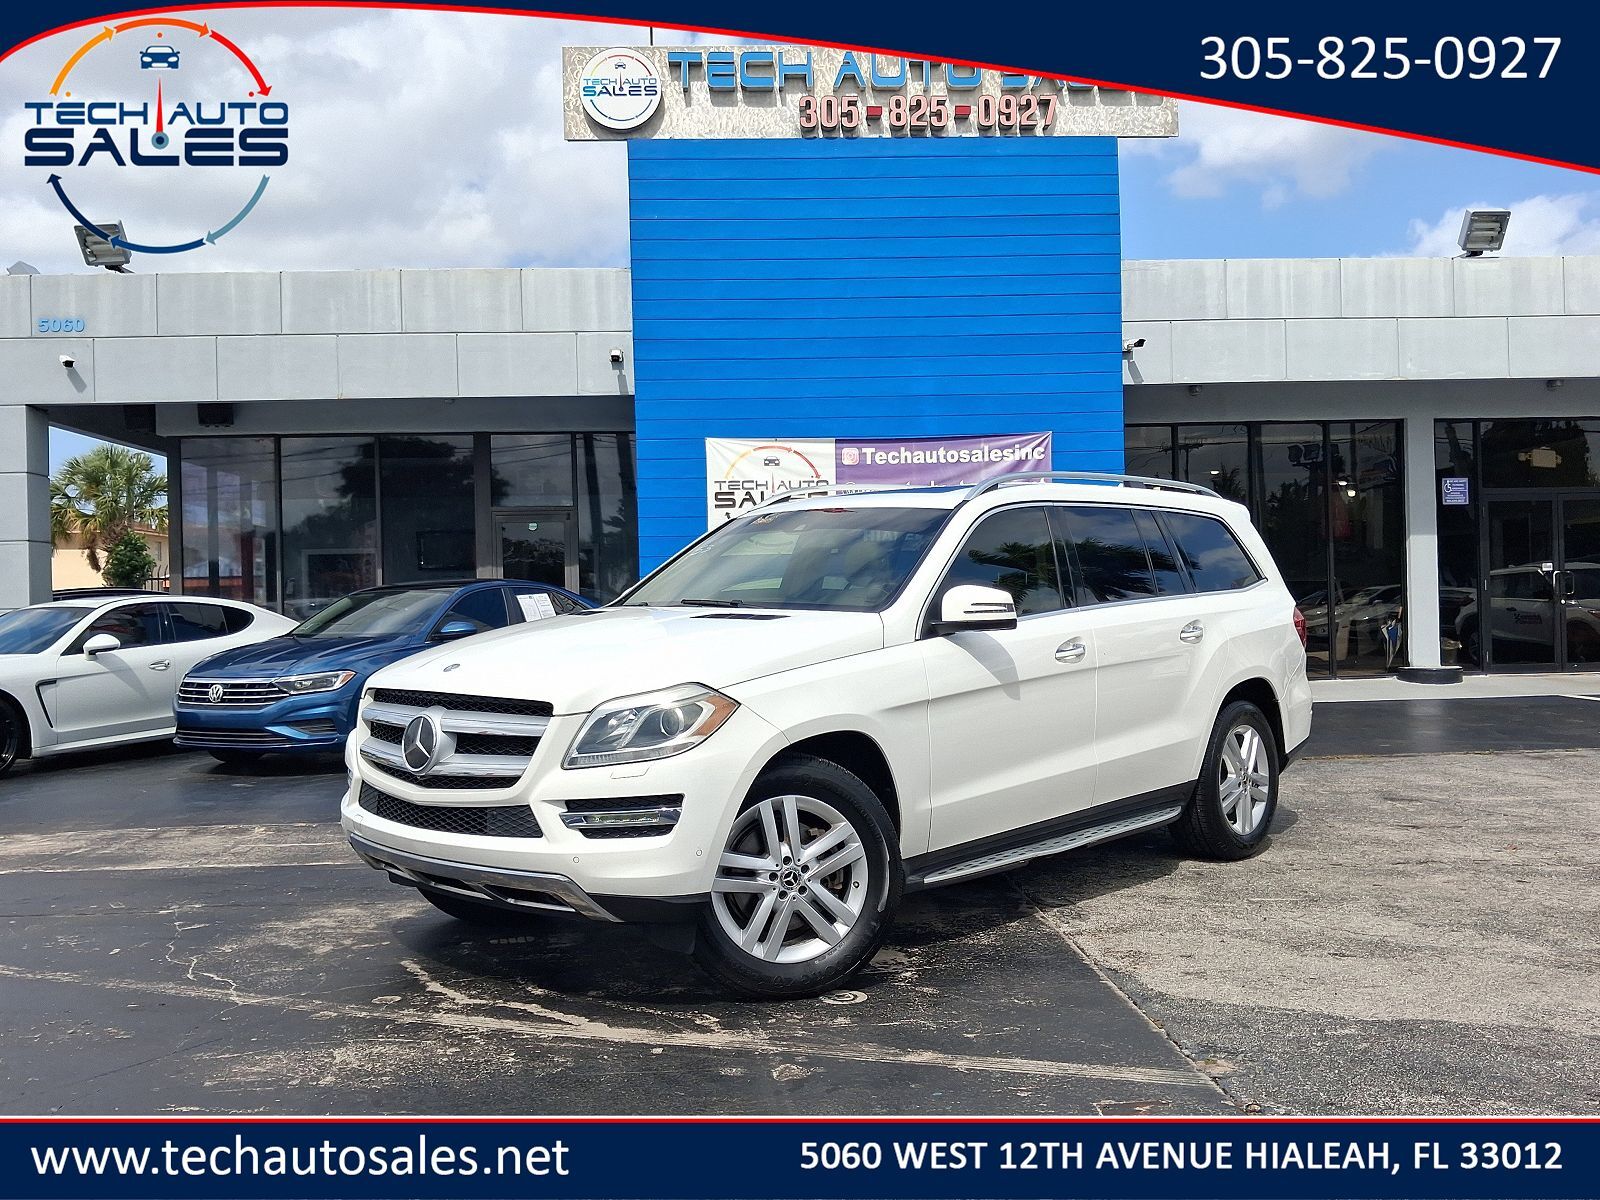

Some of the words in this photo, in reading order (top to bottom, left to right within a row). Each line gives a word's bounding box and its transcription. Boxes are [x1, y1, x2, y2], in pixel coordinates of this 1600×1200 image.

[668, 51, 813, 90] TECH
[583, 86, 657, 96] SALES
[800, 95, 1057, 128] 305-825-0927
[39, 319, 85, 332] 5060
[862, 444, 1045, 465] Techautosalesinc
[714, 480, 768, 490] TECH
